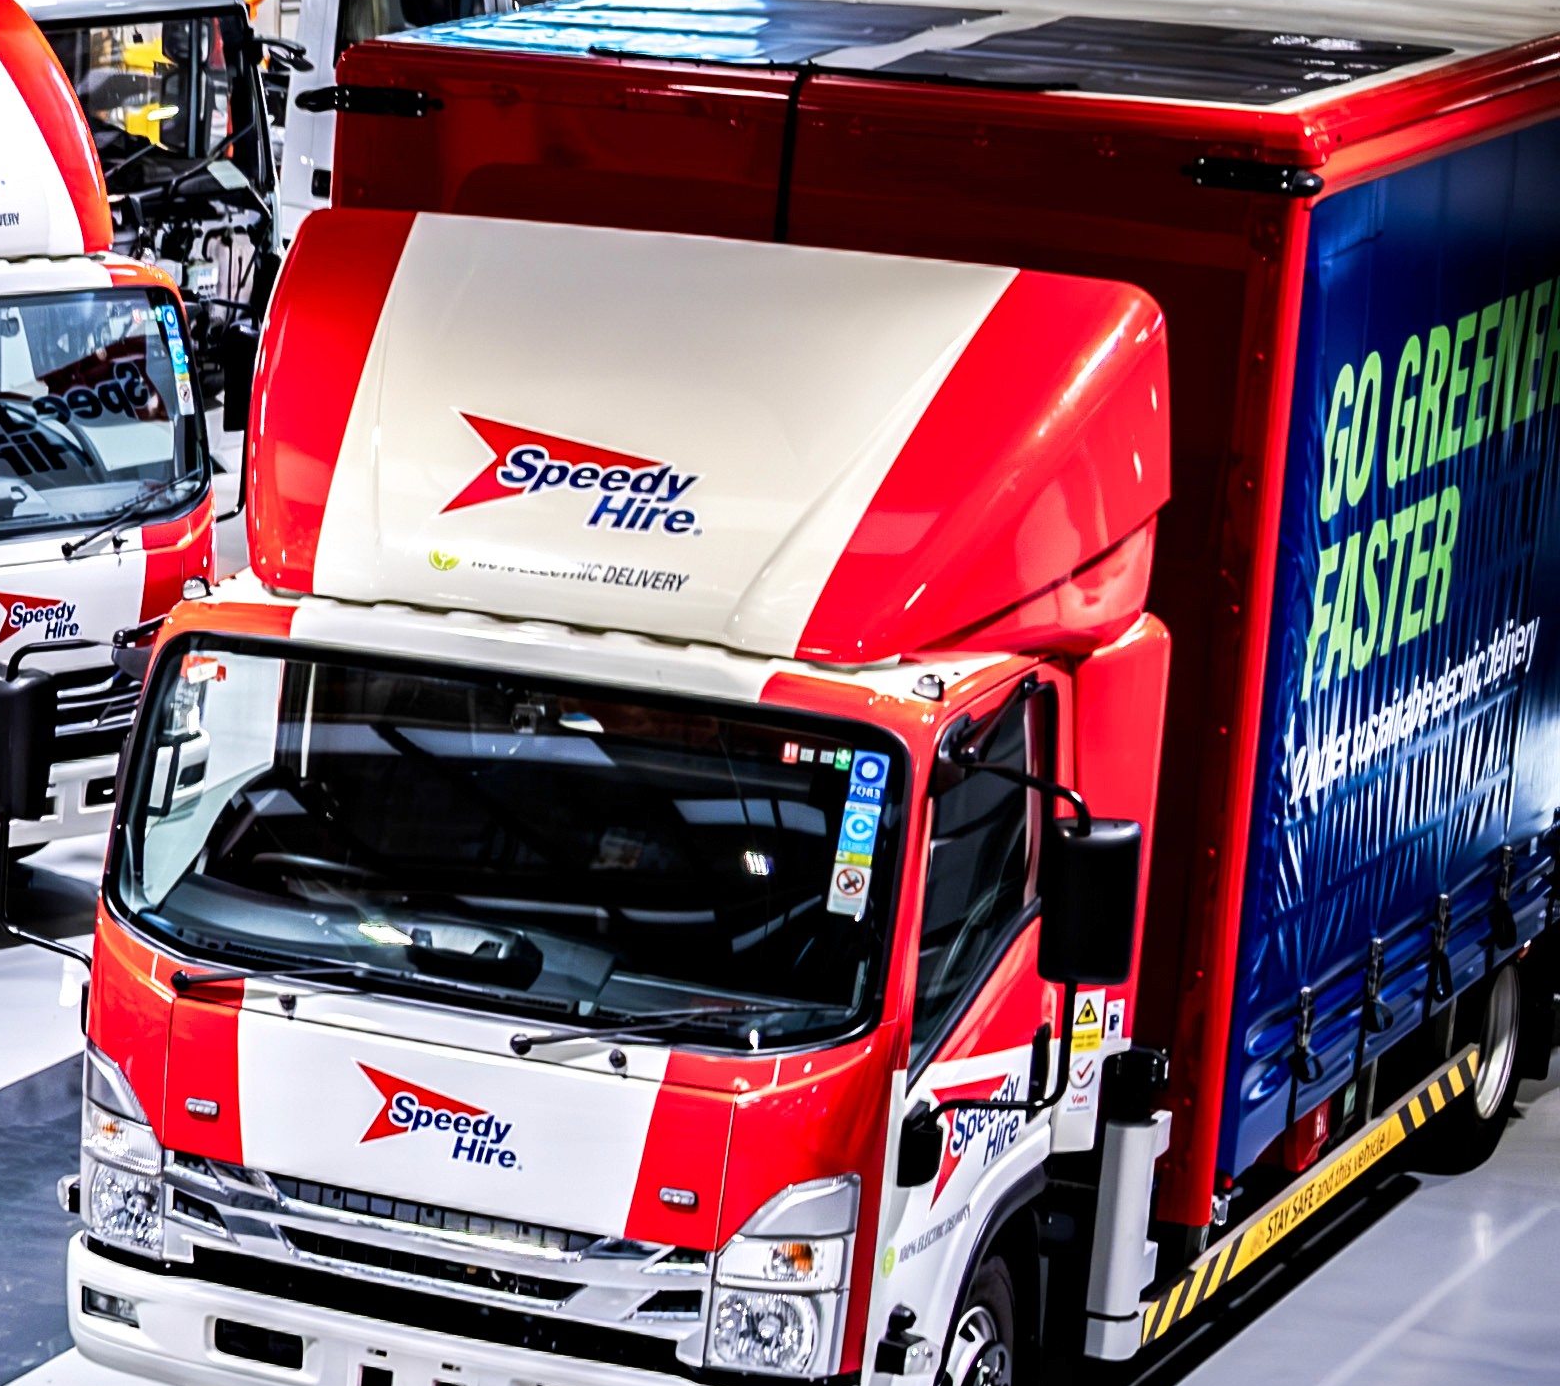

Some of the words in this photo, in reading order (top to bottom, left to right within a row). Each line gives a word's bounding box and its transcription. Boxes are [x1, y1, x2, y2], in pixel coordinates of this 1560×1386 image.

[1320, 351, 1381, 522] GO
[500, 449, 698, 503] Speedy
[586, 493, 696, 535] Hire
[602, 565, 690, 593] DELIVERY
[1301, 484, 1460, 702] FASTER
[10, 600, 76, 628] Speedy
[44, 620, 80, 640] Hire
[1350, 678, 1432, 765] sustainable
[1431, 640, 1485, 724] electric
[1484, 616, 1540, 692] delivery
[390, 1095, 512, 1147] Speedy
[951, 1073, 1019, 1158] Speedy
[983, 1115, 1019, 1167] Hire
[452, 1135, 517, 1169] Hire
[1265, 1205, 1291, 1244] STAY
[1290, 1183, 1315, 1224] SAFE
[1315, 1171, 1334, 1203] and
[1353, 1131, 1386, 1171] vehicle
